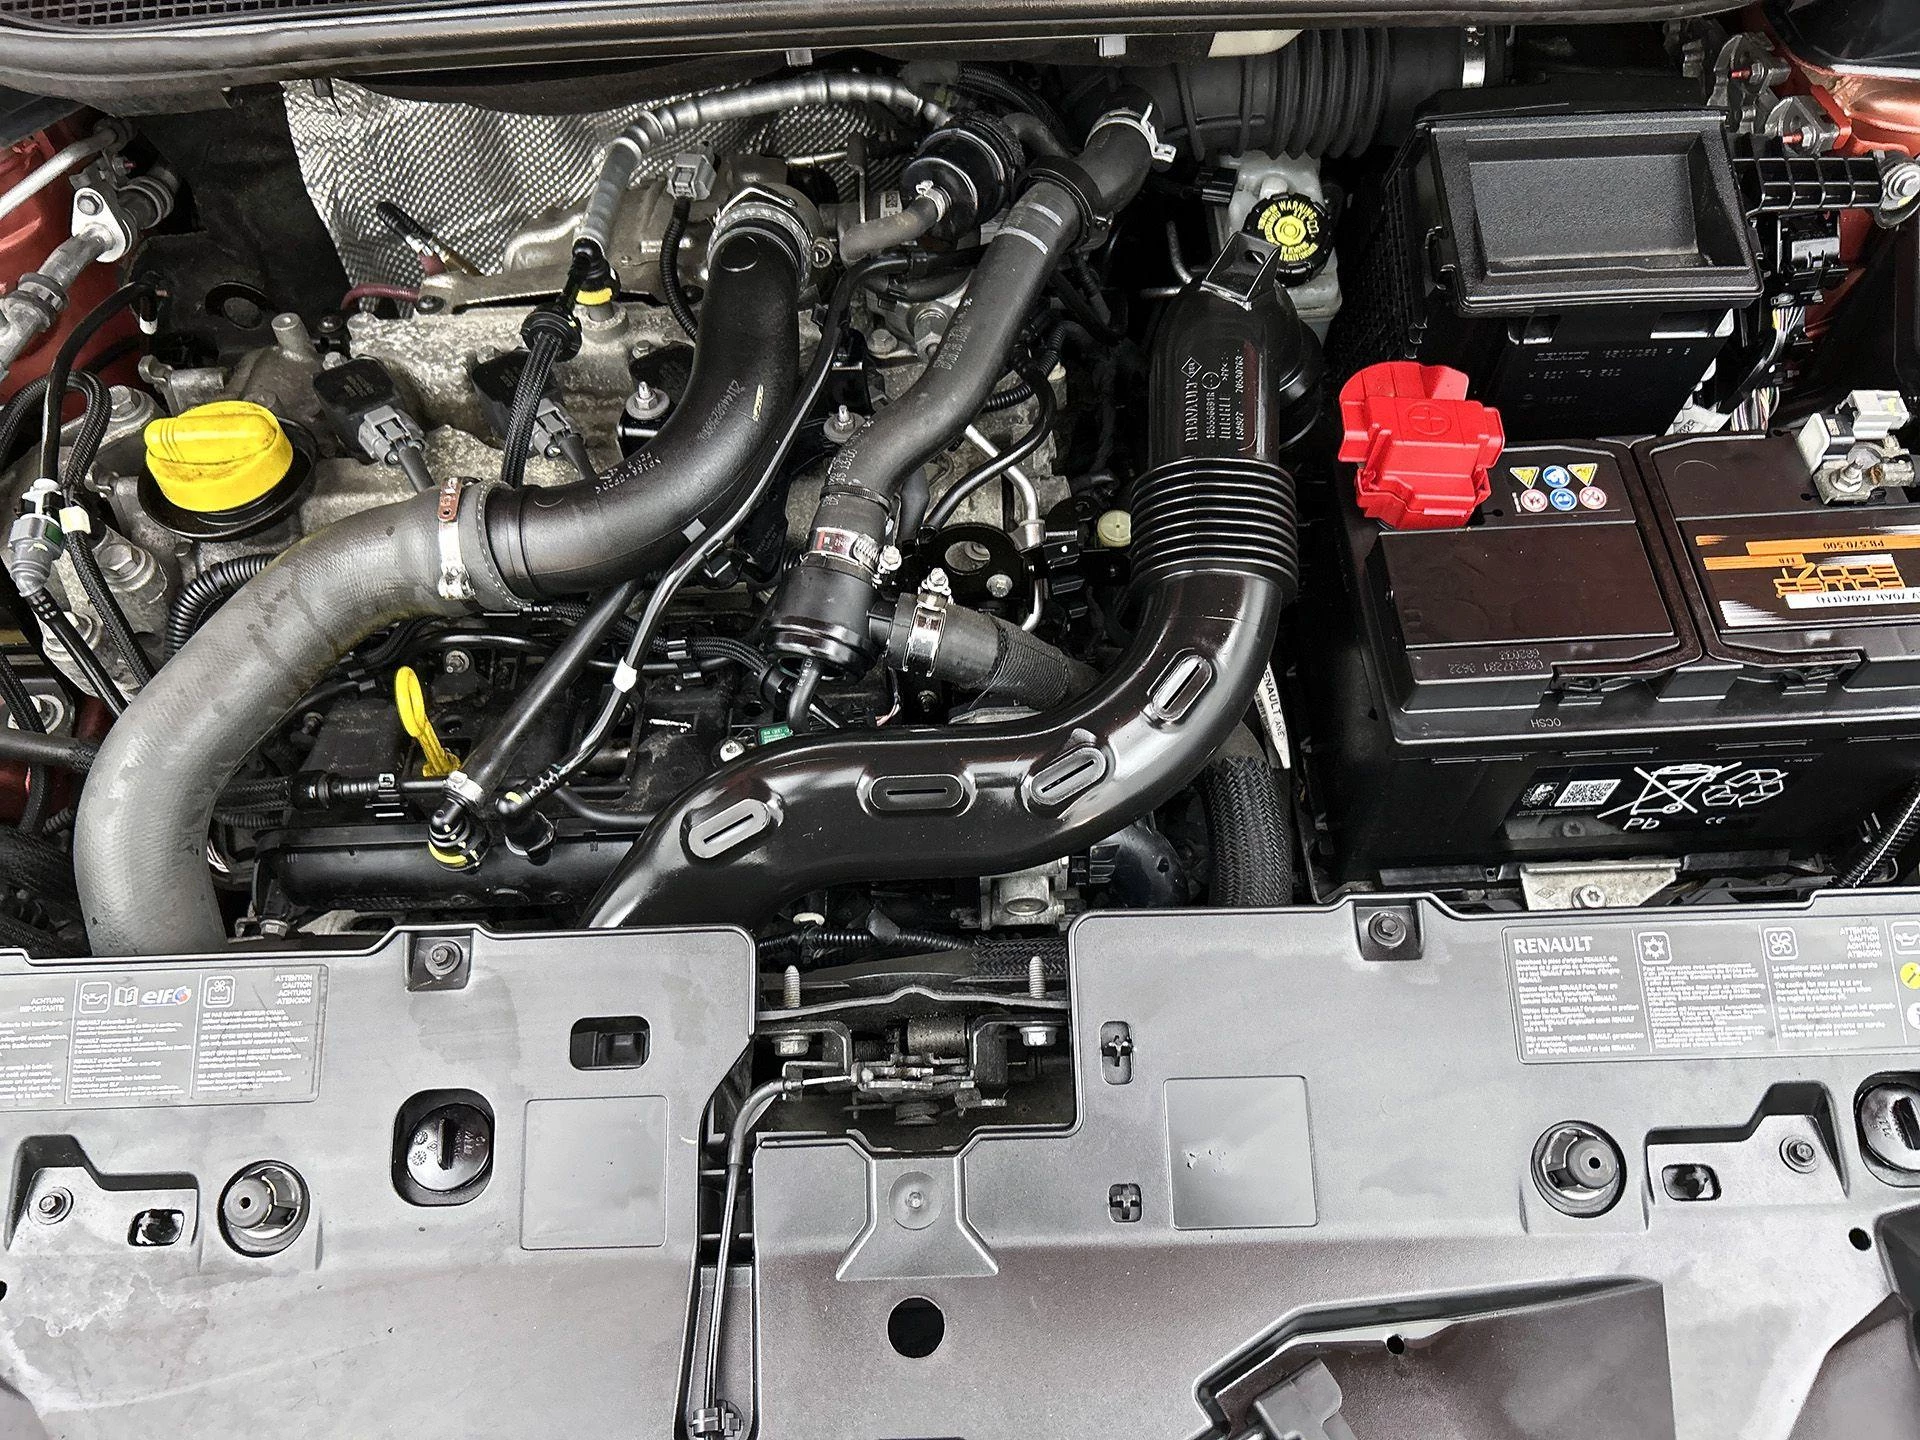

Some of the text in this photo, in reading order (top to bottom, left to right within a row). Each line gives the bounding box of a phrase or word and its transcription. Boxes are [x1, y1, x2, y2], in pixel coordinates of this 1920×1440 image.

[1278, 200, 1317, 220] WARNING
[1622, 817, 1660, 831] Pb
[1513, 936, 1593, 954] RENAULT
[275, 974, 313, 983] ATTENTION
[282, 981, 313, 989] CAUTION
